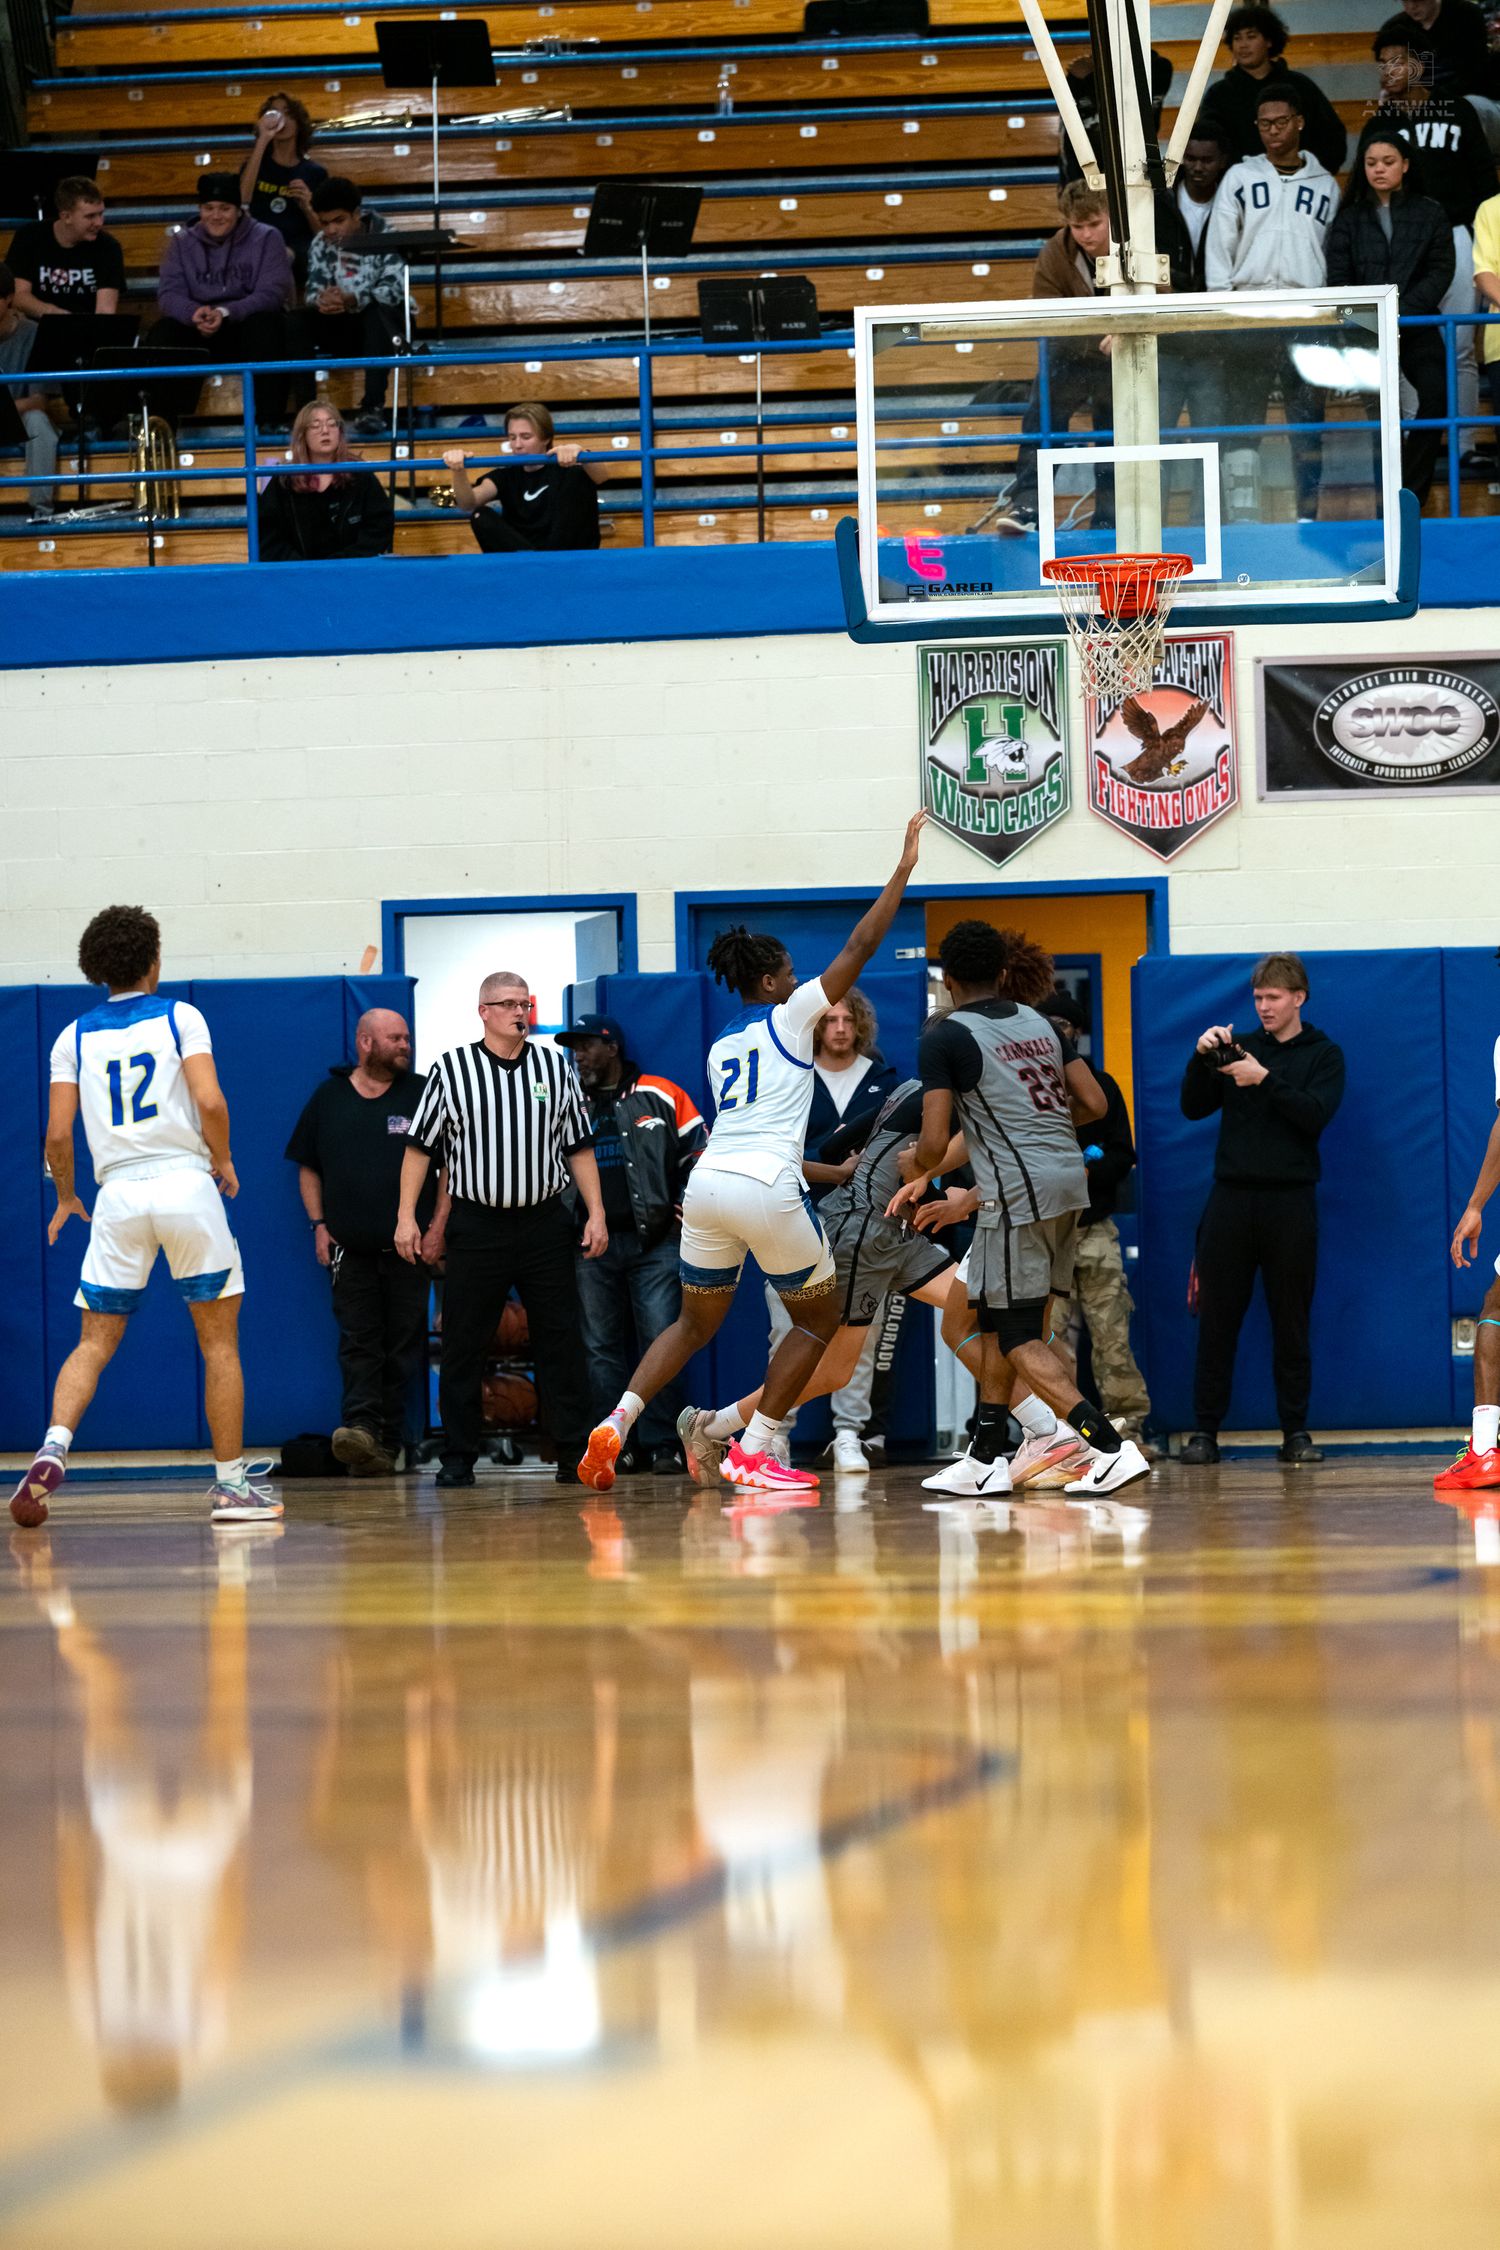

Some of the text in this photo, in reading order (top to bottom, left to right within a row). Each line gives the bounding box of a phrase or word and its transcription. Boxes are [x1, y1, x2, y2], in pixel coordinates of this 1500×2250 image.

[39, 265, 97, 287] HOPE
[928, 582, 993, 593] GARED
[927, 647, 1061, 744] HARRISON
[1319, 671, 1497, 721] SOUTHWEST OHIO CONFERENCE
[1349, 705, 1461, 739] SWOC
[962, 703, 1029, 785] H
[1329, 736, 1491, 780] INTEGRITY SPORTSMANSHIP LEADERSHIP
[928, 757, 1064, 836] WILDCATS
[1095, 748, 1231, 829] FIGHTING OWLS
[106, 1051, 159, 1127] 12
[718, 1047, 760, 1111] 21
[595, 1143, 624, 1160] OTBA
[876, 1295, 907, 1371] COLORADO
